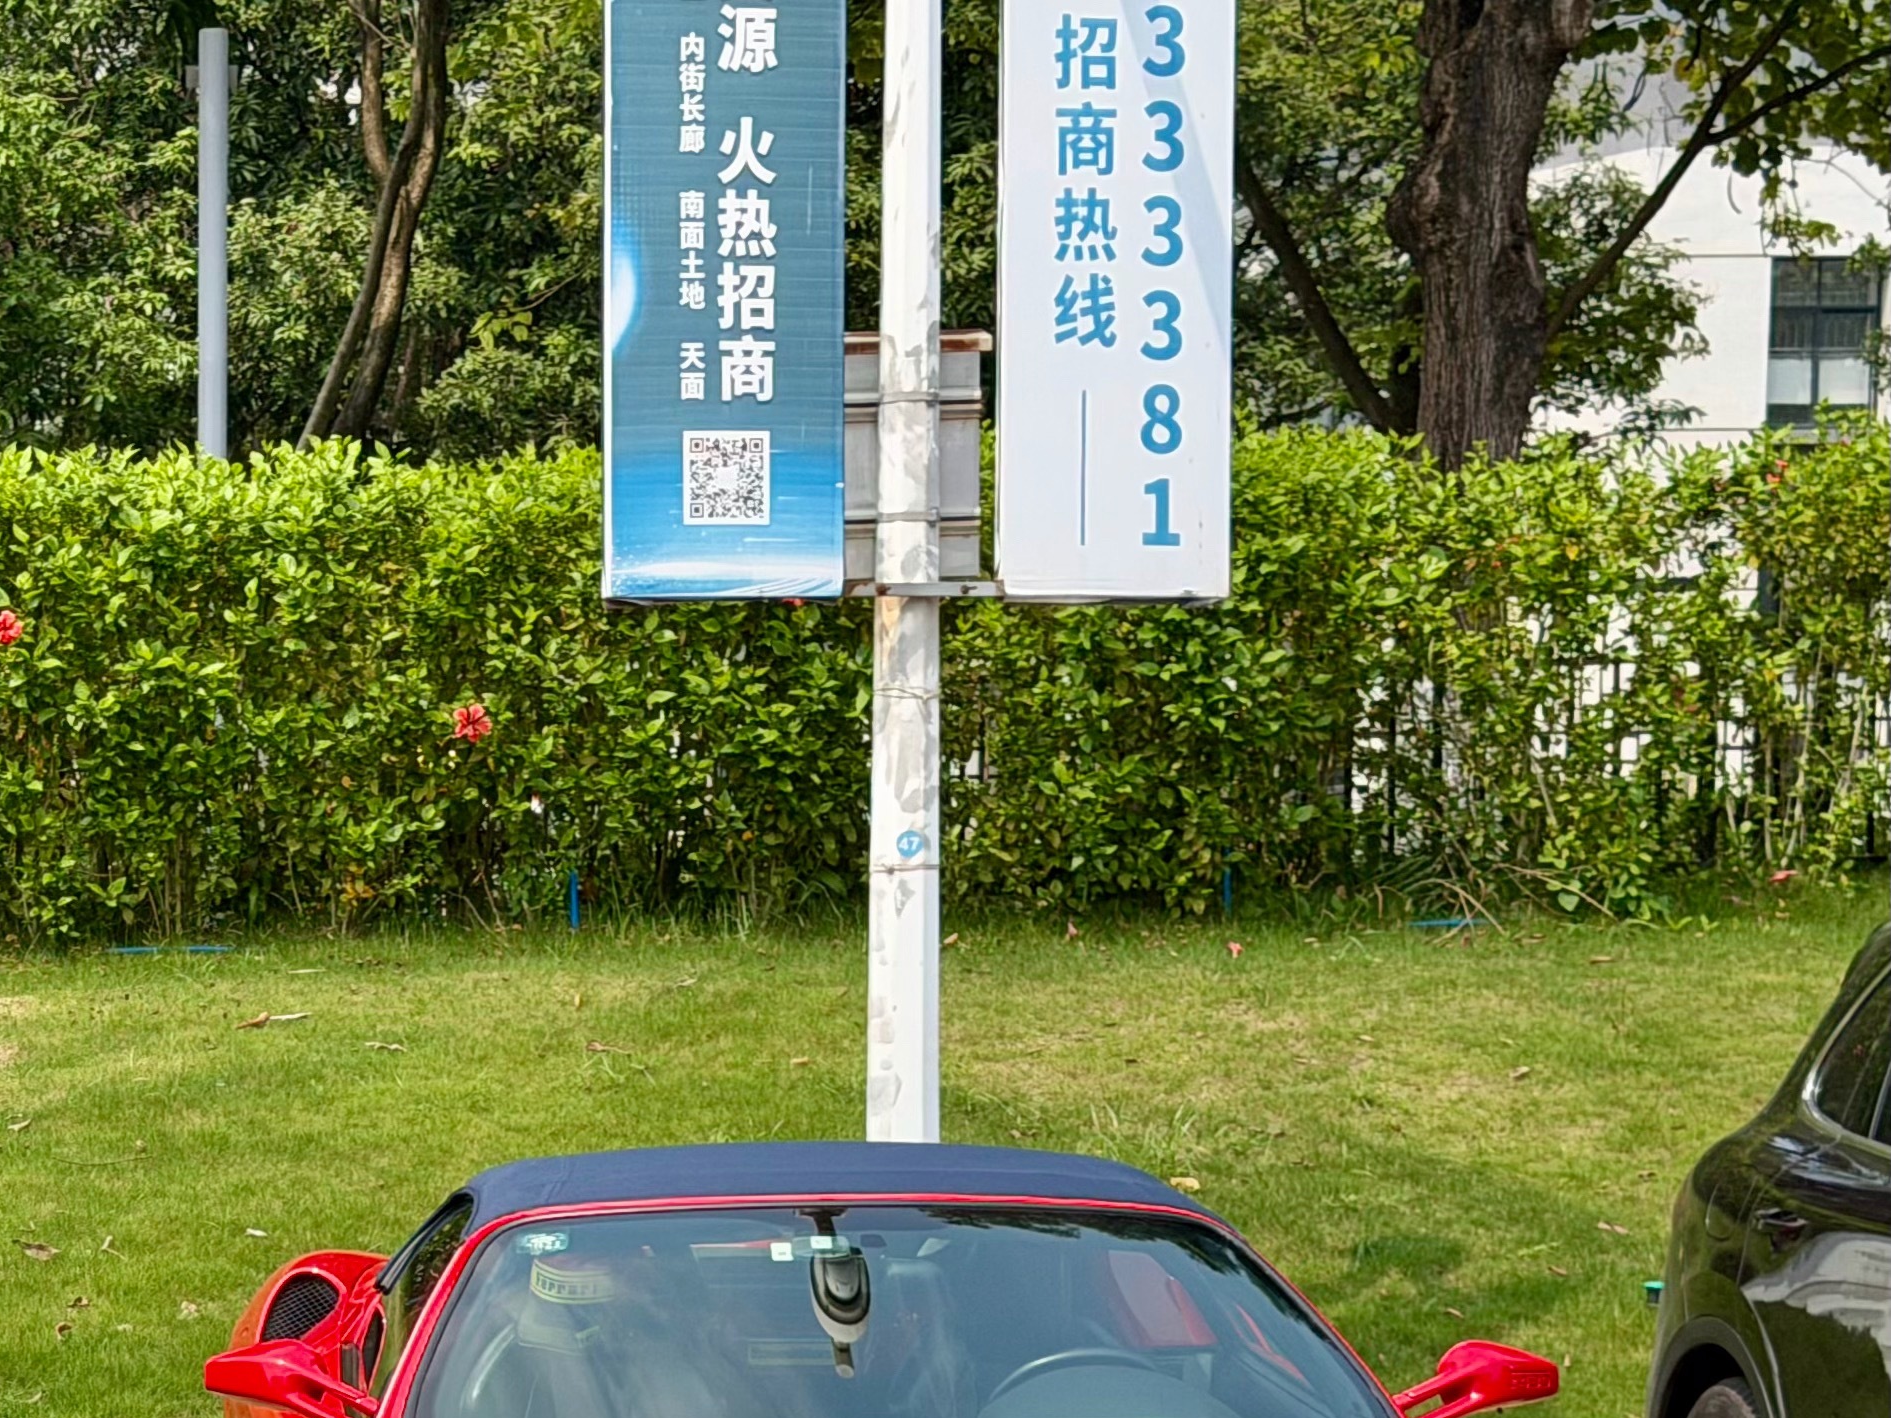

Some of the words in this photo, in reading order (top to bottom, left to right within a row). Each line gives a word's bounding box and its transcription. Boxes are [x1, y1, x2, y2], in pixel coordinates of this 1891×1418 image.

[679, 31, 706, 154] 内街长廊
[717, 4, 778, 73] 源
[1054, 13, 1118, 348] 招商热线
[679, 190, 706, 310] 南面土地
[717, 116, 777, 402] 火热招商
[1139, 5, 1186, 546] 333381
[679, 342, 706, 400] 天面
[898, 836, 920, 851] 47
